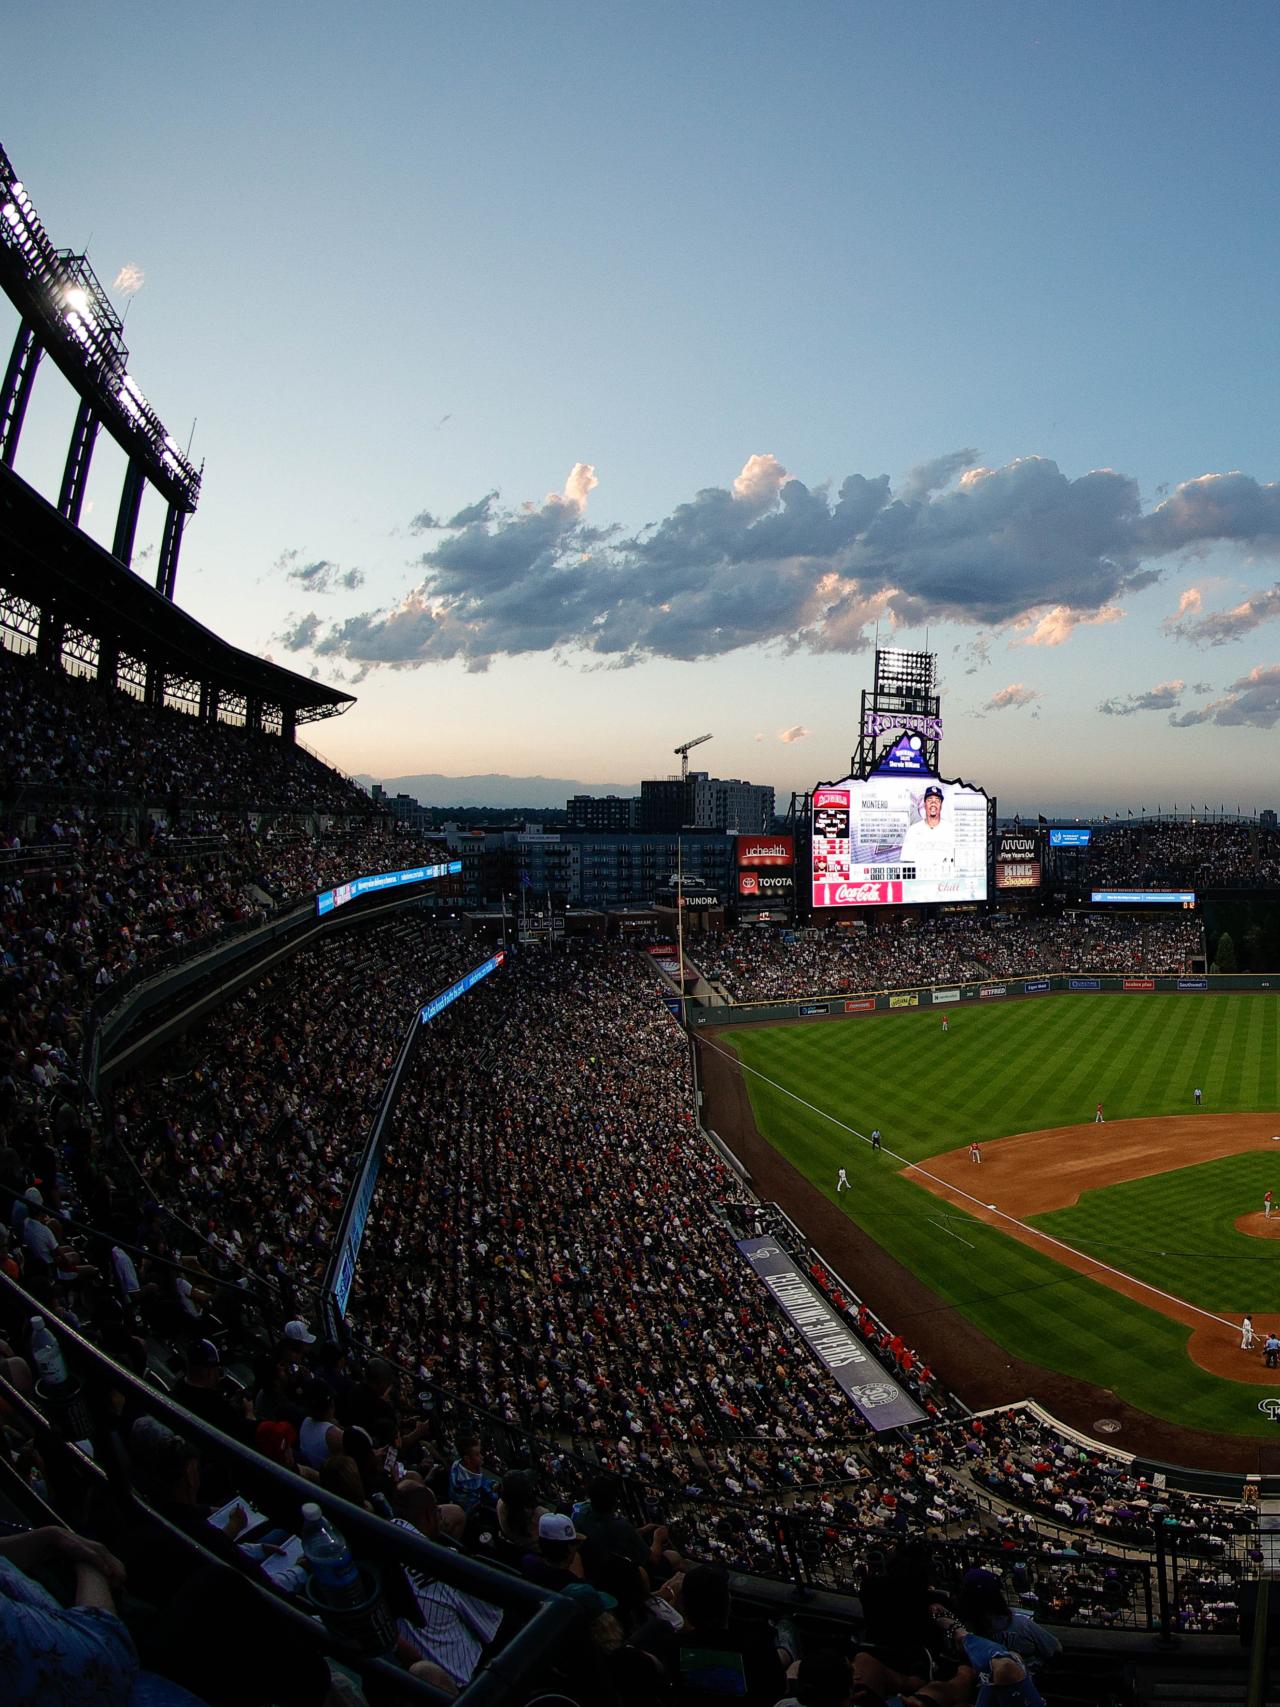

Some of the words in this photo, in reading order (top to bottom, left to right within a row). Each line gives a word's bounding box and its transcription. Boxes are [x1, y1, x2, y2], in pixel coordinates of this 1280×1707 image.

[864, 712, 943, 740] ROCKIES
[861, 800, 889, 809] MONTERO
[745, 844, 786, 855] uchealth
[1004, 865, 1032, 876] KING
[758, 878, 793, 887] TOYOTA
[1003, 875, 1034, 887] Soopers
[685, 897, 718, 905] TUNDRA
[981, 988, 1005, 996] BETFRED
[765, 1272, 830, 1326] CELEBRATING
[802, 1322, 841, 1338] 30
[813, 1333, 867, 1368] YEARS
[865, 1387, 886, 1401] 30
